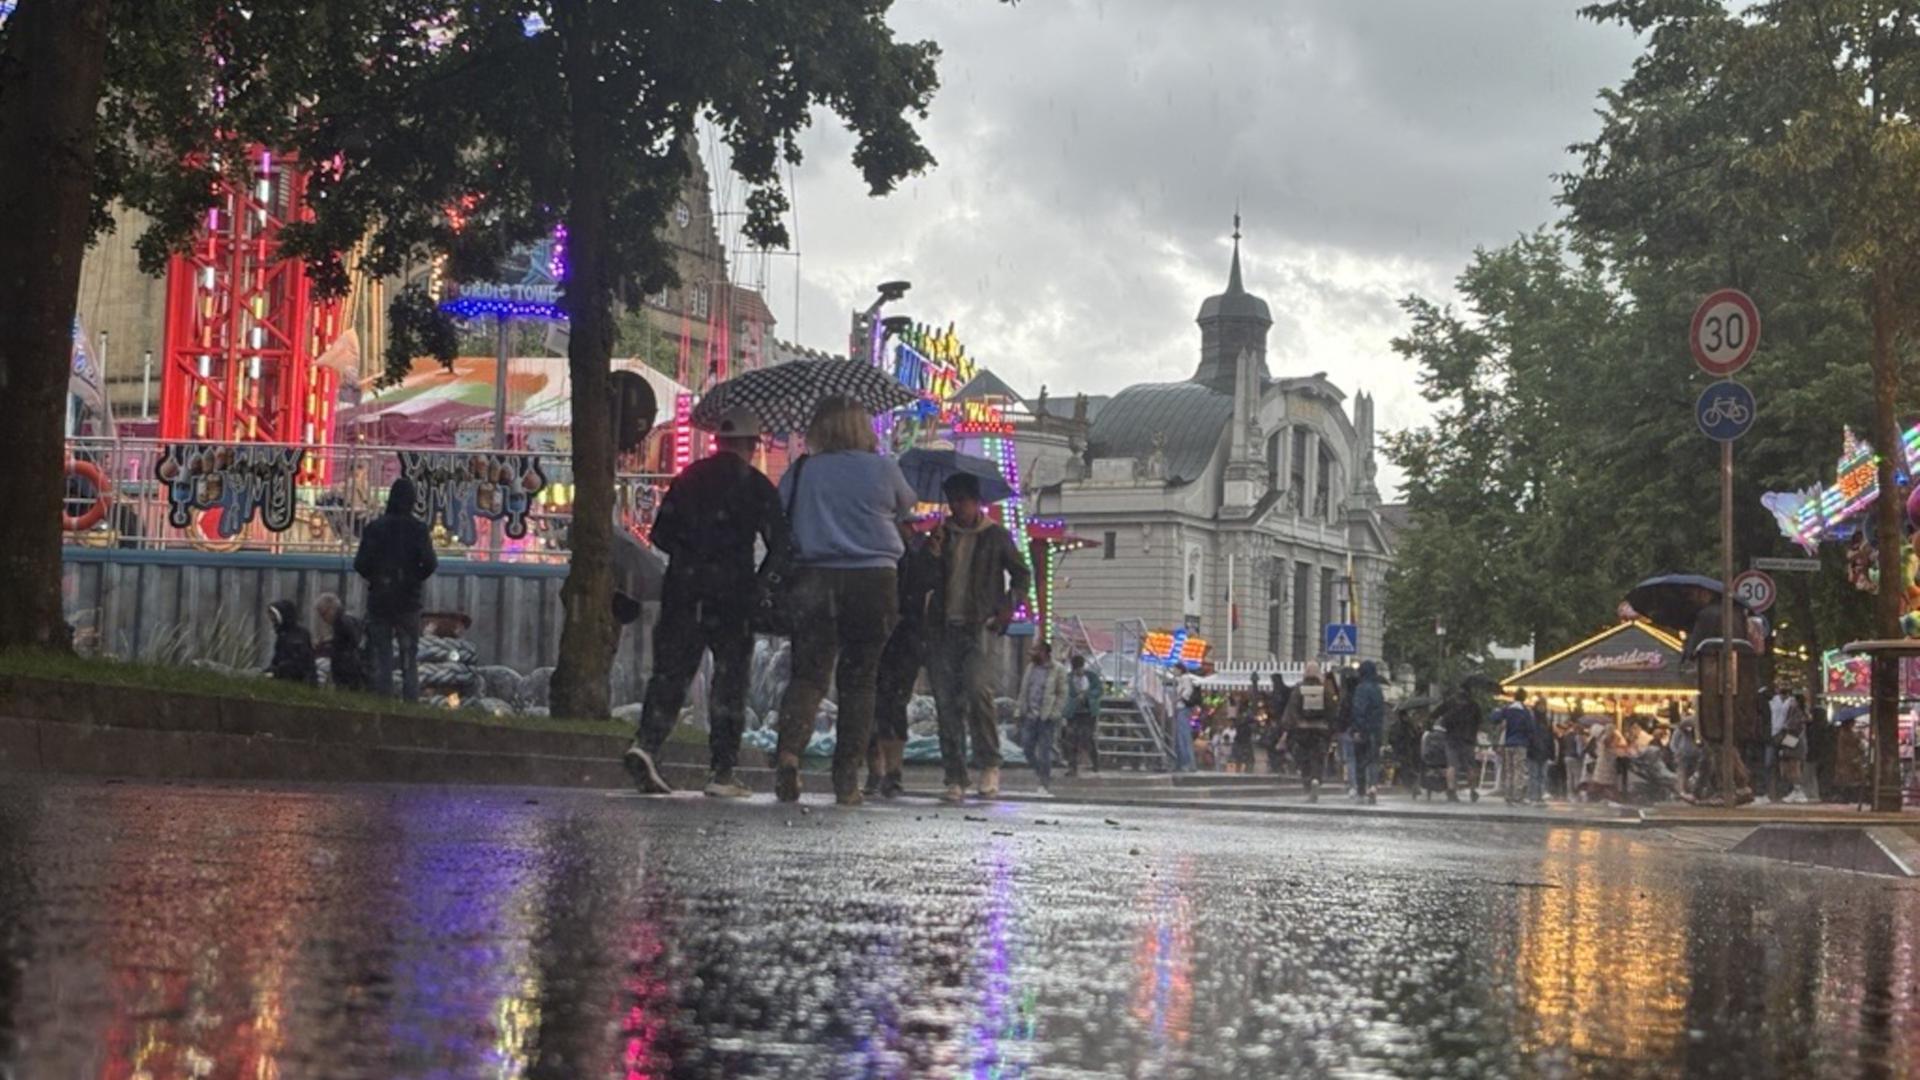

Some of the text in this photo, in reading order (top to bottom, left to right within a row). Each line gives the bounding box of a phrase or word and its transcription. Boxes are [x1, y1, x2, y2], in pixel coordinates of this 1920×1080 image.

[456, 282, 560, 302] ORDIC TOWE
[1705, 313, 1743, 352] 30
[1742, 583, 1765, 601] 30
[1577, 648, 1662, 674] Schneider's
